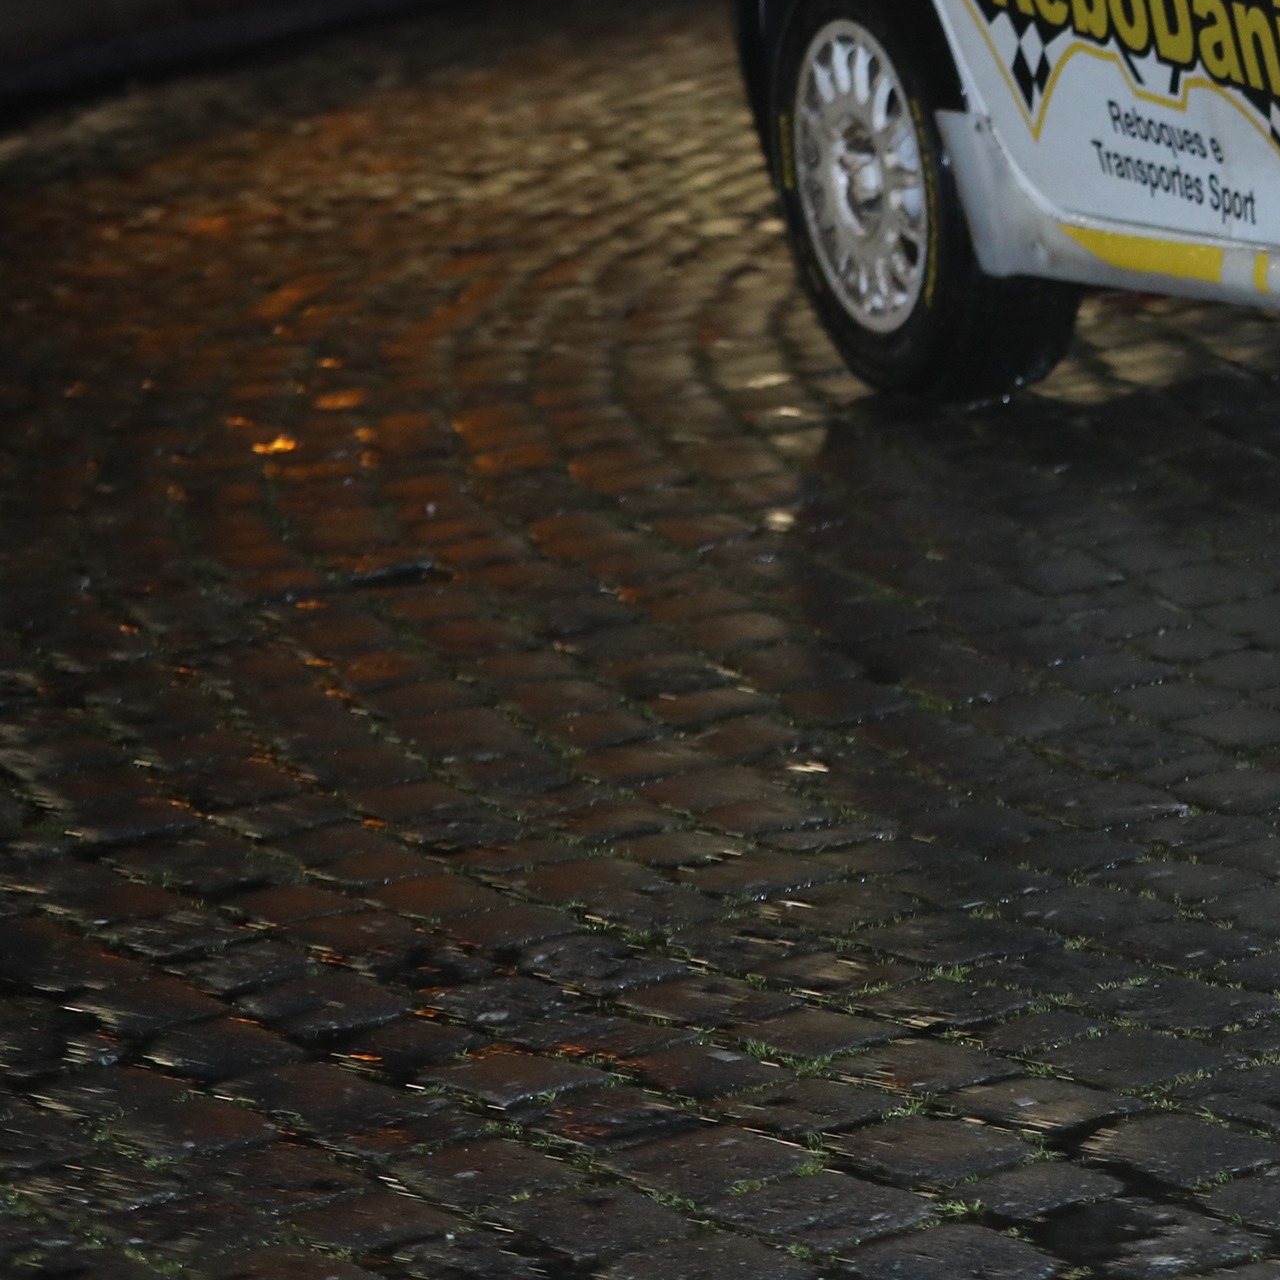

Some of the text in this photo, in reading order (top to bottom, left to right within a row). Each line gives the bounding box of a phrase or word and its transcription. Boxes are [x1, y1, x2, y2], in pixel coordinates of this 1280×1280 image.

[1107, 99, 1226, 165] Reboques e
[1091, 139, 1258, 225] Transportes Sport
